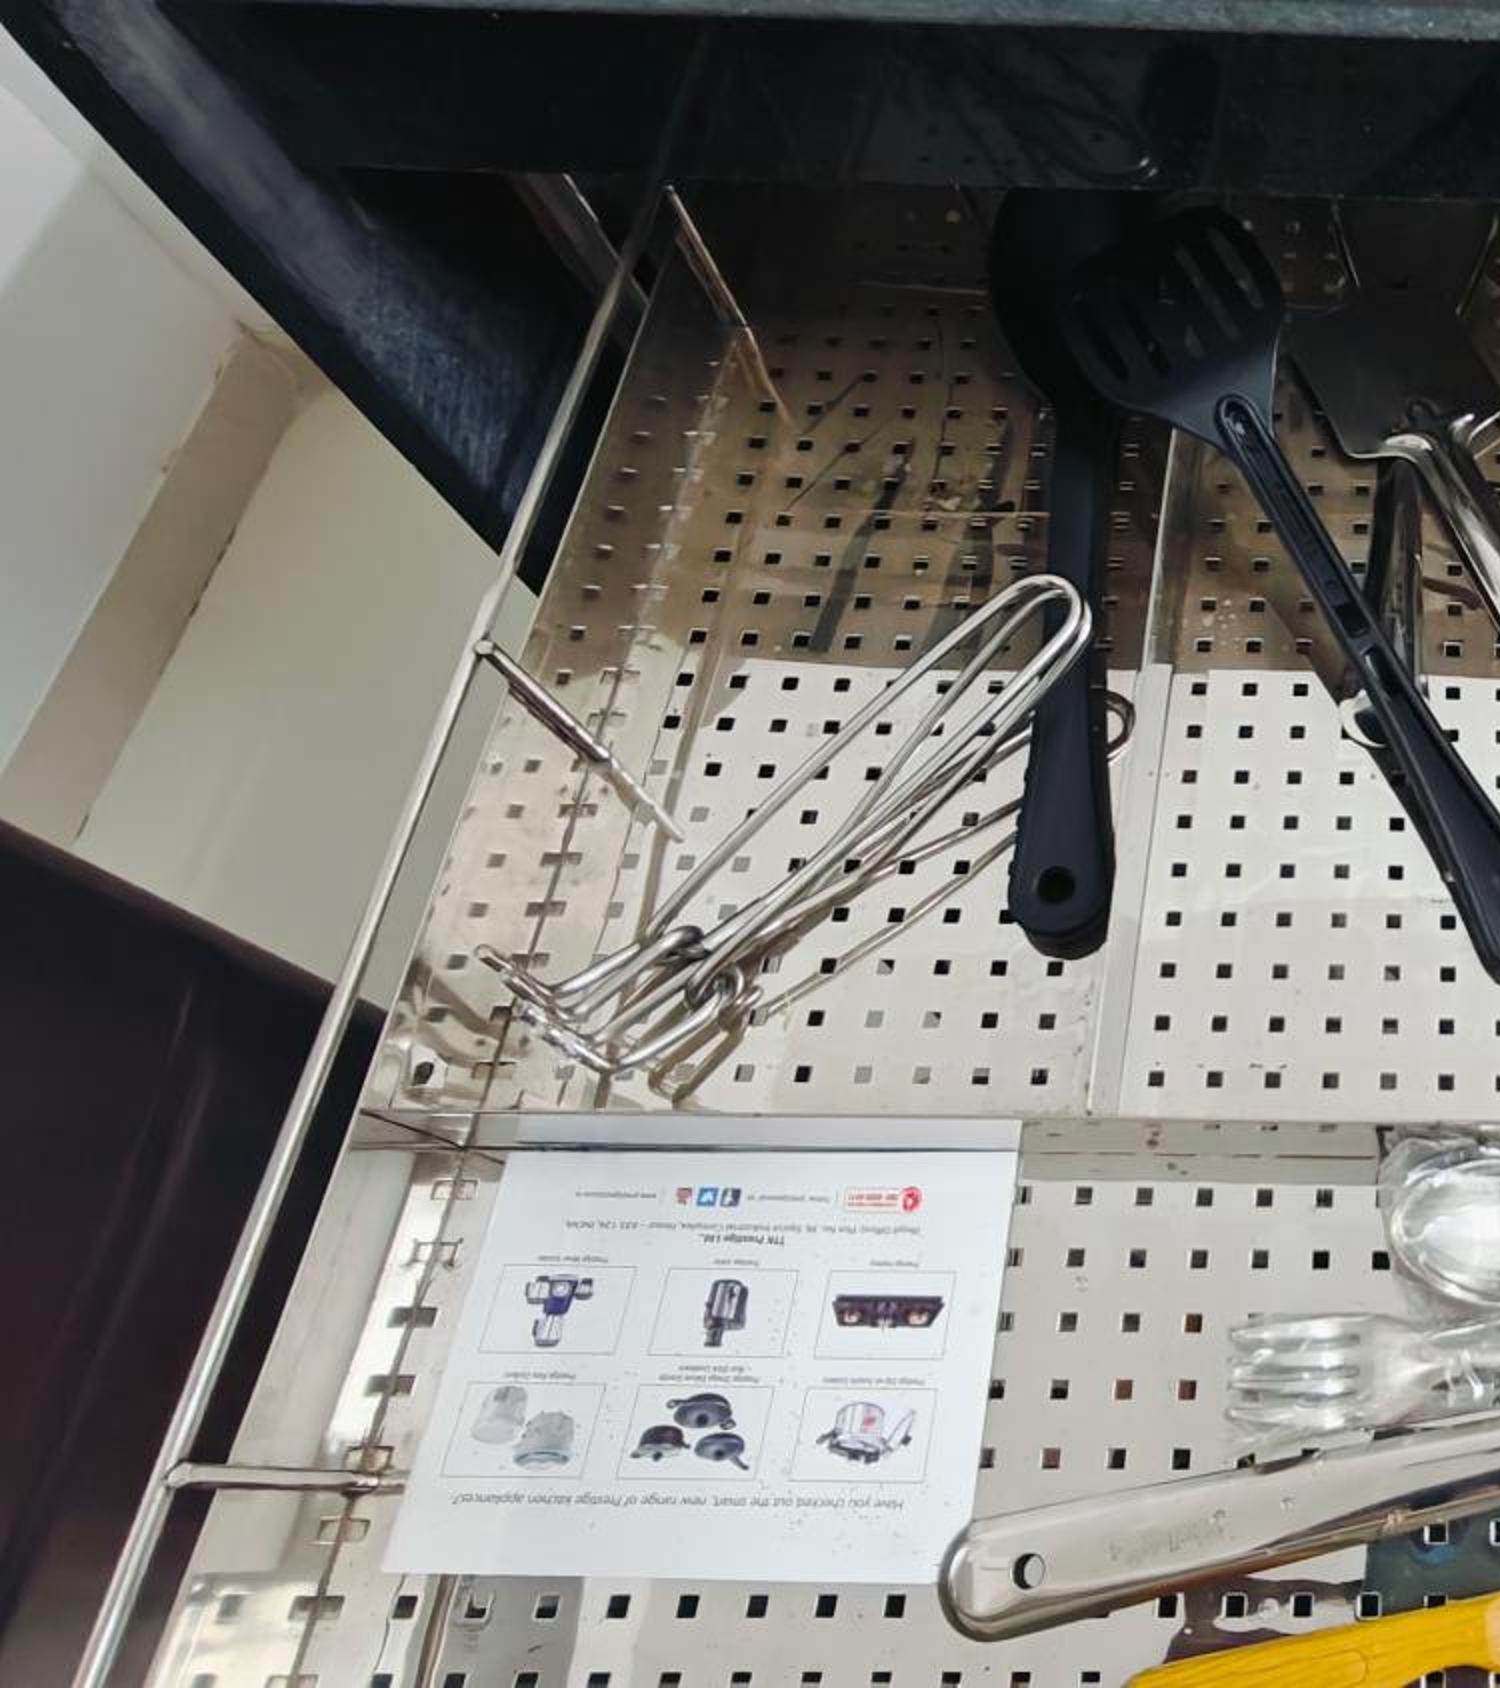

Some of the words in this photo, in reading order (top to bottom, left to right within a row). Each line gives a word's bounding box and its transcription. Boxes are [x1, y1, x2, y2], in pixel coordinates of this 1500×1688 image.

[723, 1233, 765, 1245] Prestige
[451, 1492, 525, 1505] appliances?
[528, 1495, 572, 1506] kitchen
[575, 1492, 622, 1507] Prestige
[622, 1496, 637, 1507] of
[640, 1493, 676, 1505] range
[680, 1497, 707, 1505] new
[750, 1497, 769, 1508] the
[773, 1497, 793, 1507] out
[796, 1497, 845, 1510] checked
[848, 1496, 872, 1507] you
[874, 1499, 904, 1510] Have
